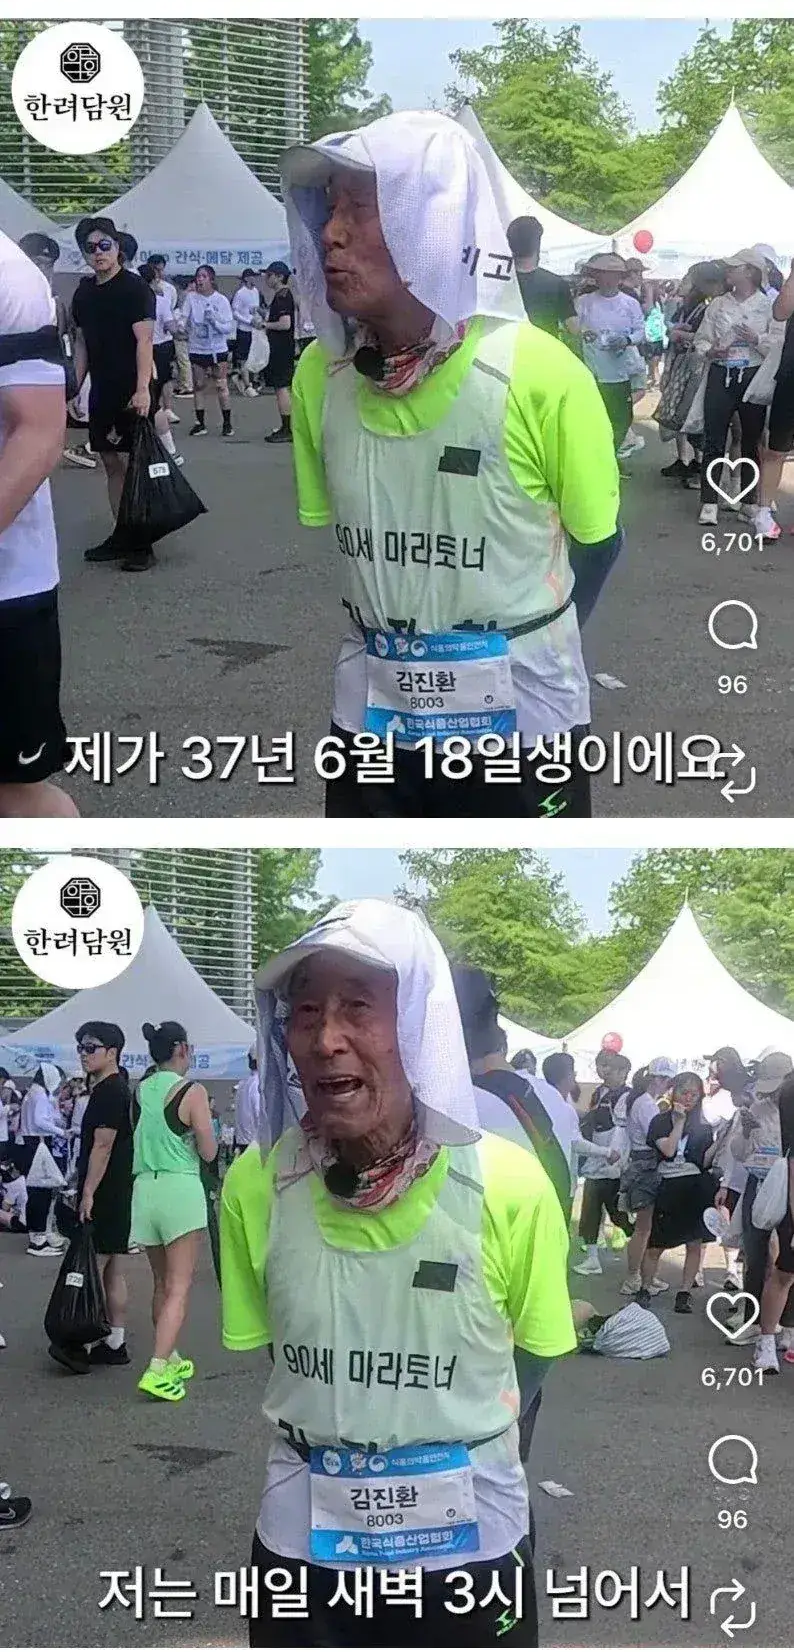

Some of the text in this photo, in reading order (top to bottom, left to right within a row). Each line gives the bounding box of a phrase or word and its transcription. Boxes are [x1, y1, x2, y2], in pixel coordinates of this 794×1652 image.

[335, 526, 486, 572] 90세 마라토너
[396, 670, 456, 693] 김진환
[410, 696, 444, 710] 8003
[283, 1344, 457, 1391] 90세 마라토너
[349, 1486, 419, 1510] 김진환
[366, 1513, 404, 1527] 8003
